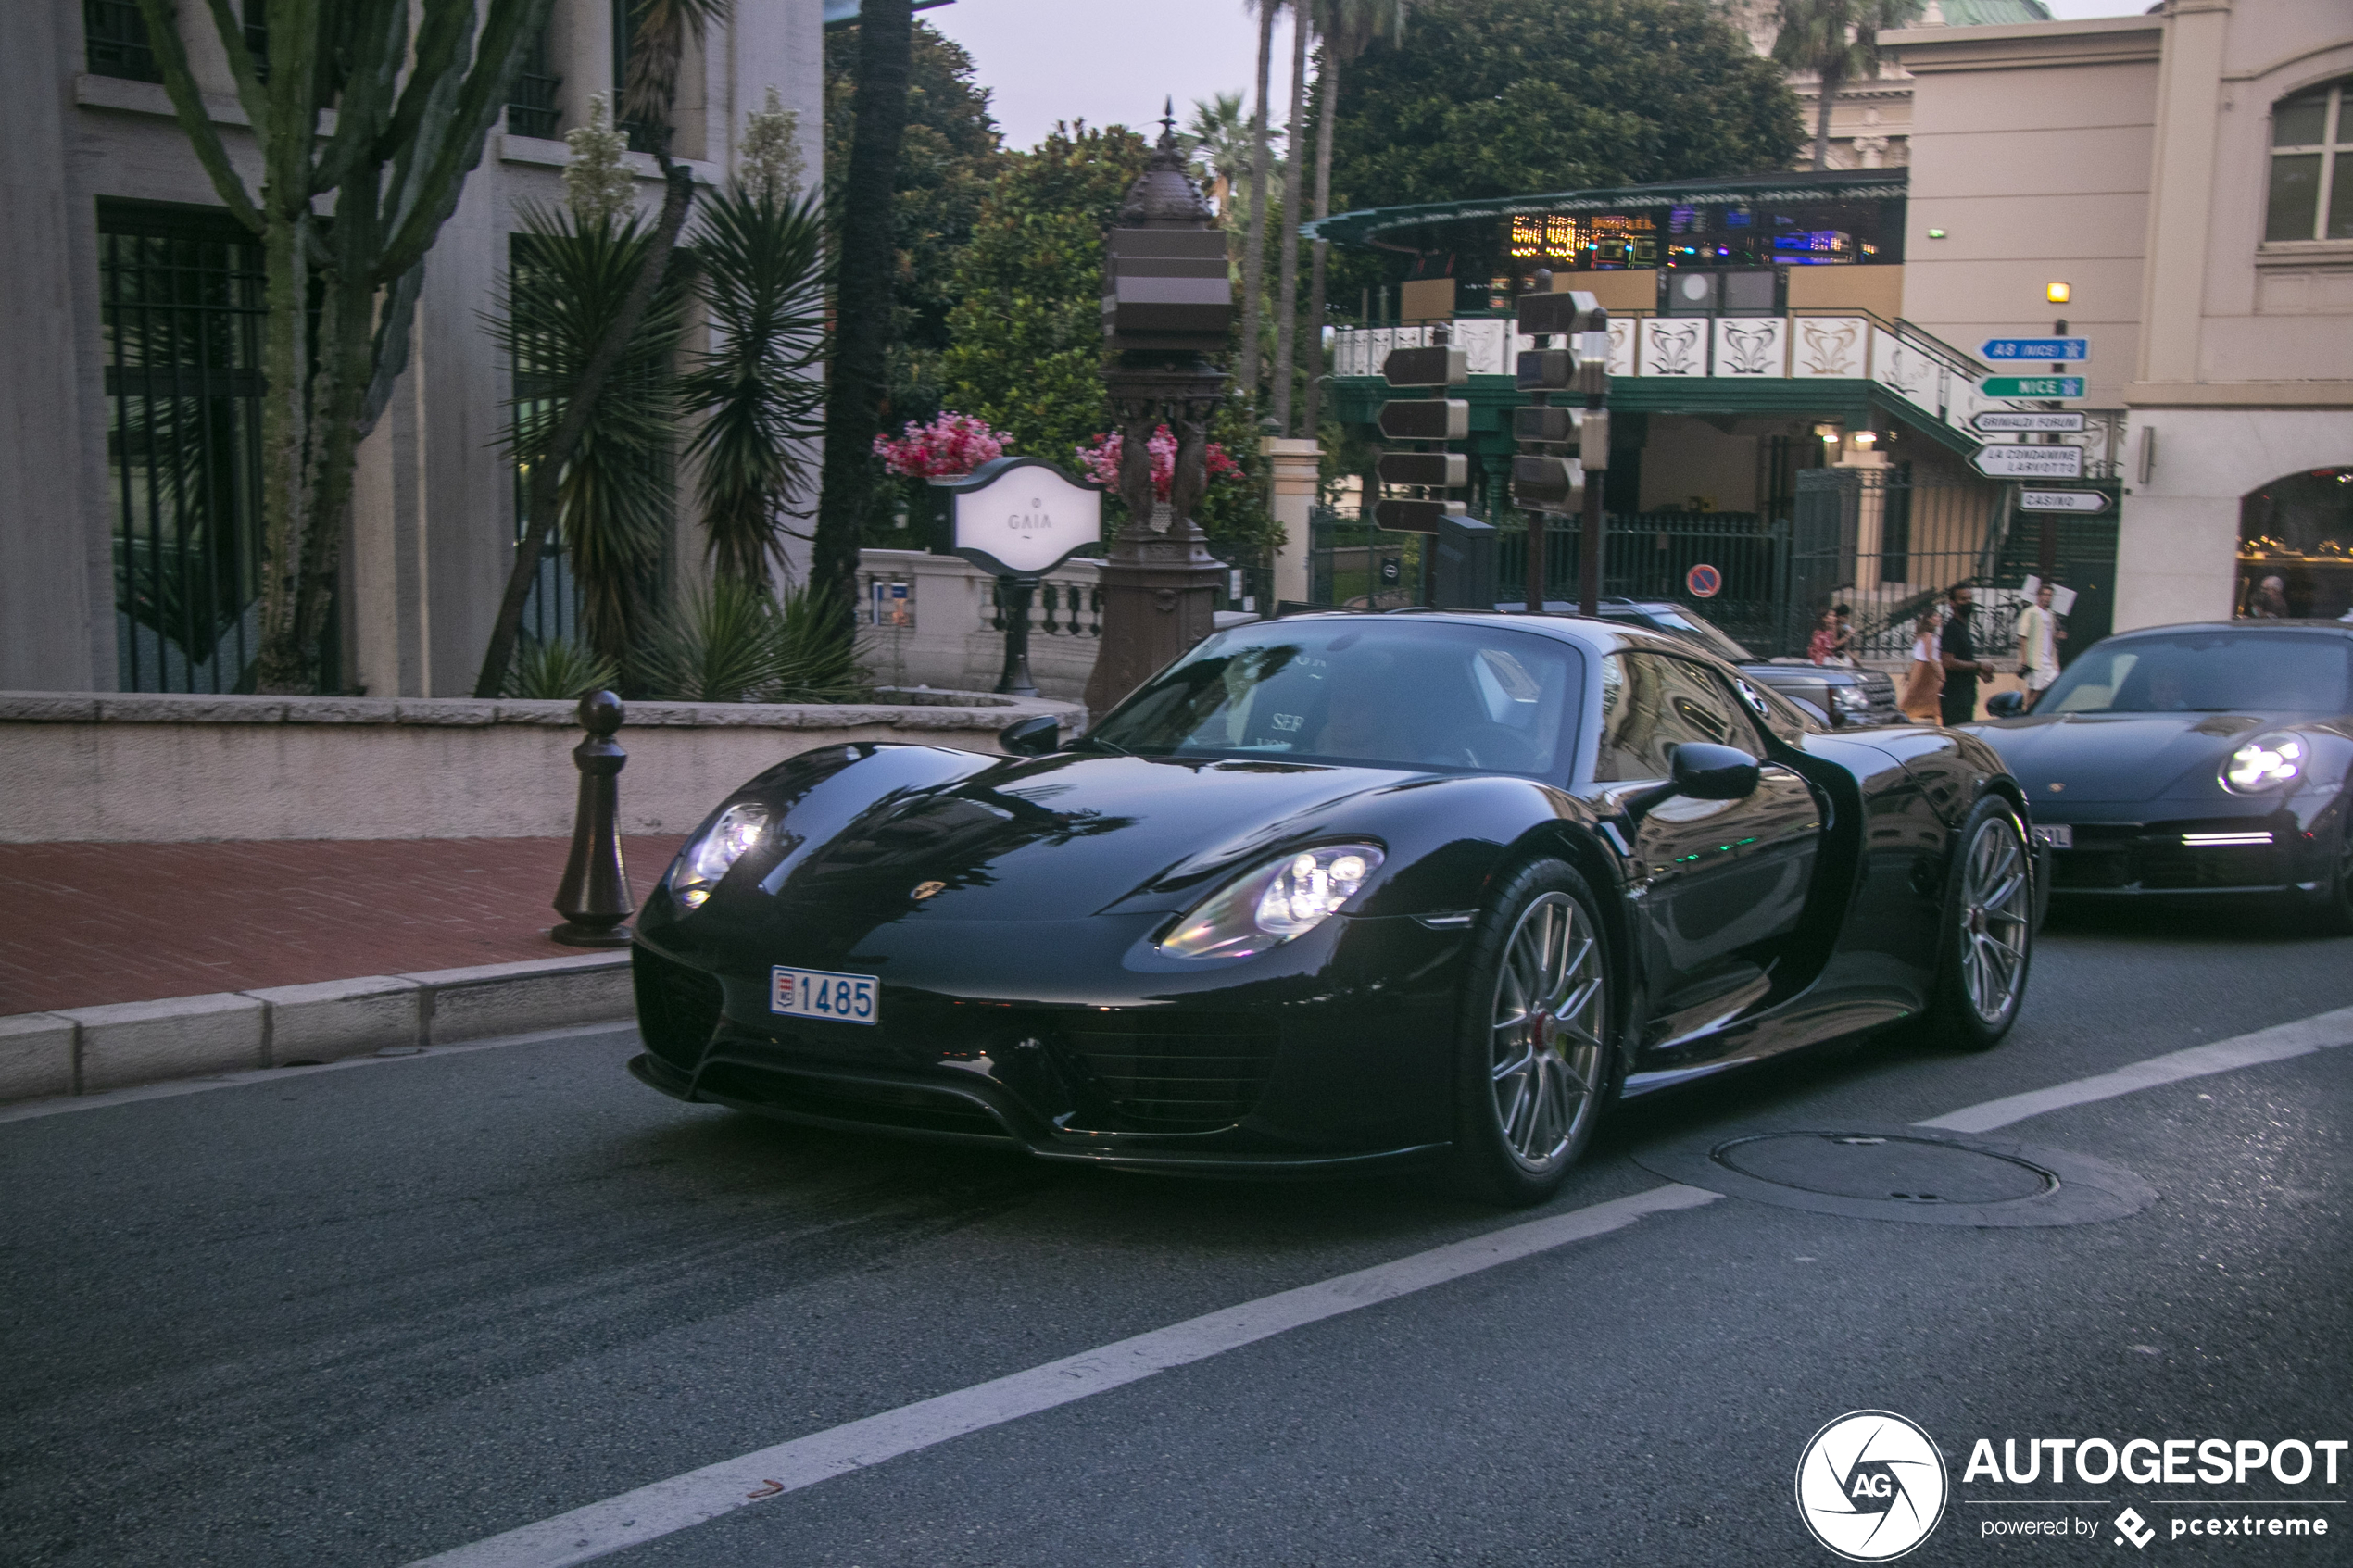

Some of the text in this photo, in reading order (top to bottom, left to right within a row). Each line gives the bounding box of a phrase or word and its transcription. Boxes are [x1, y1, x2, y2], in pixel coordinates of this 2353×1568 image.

[2018, 380, 2057, 394] NICE
[1982, 417, 2078, 428] GRIMALDI FORUM
[1987, 449, 2077, 461] LA CONDAMINE
[2007, 462, 2076, 473] LARVOTTO
[2024, 495, 2075, 507] CASINO
[1008, 514, 1052, 530] GAIA
[801, 976, 872, 1017] 1485
